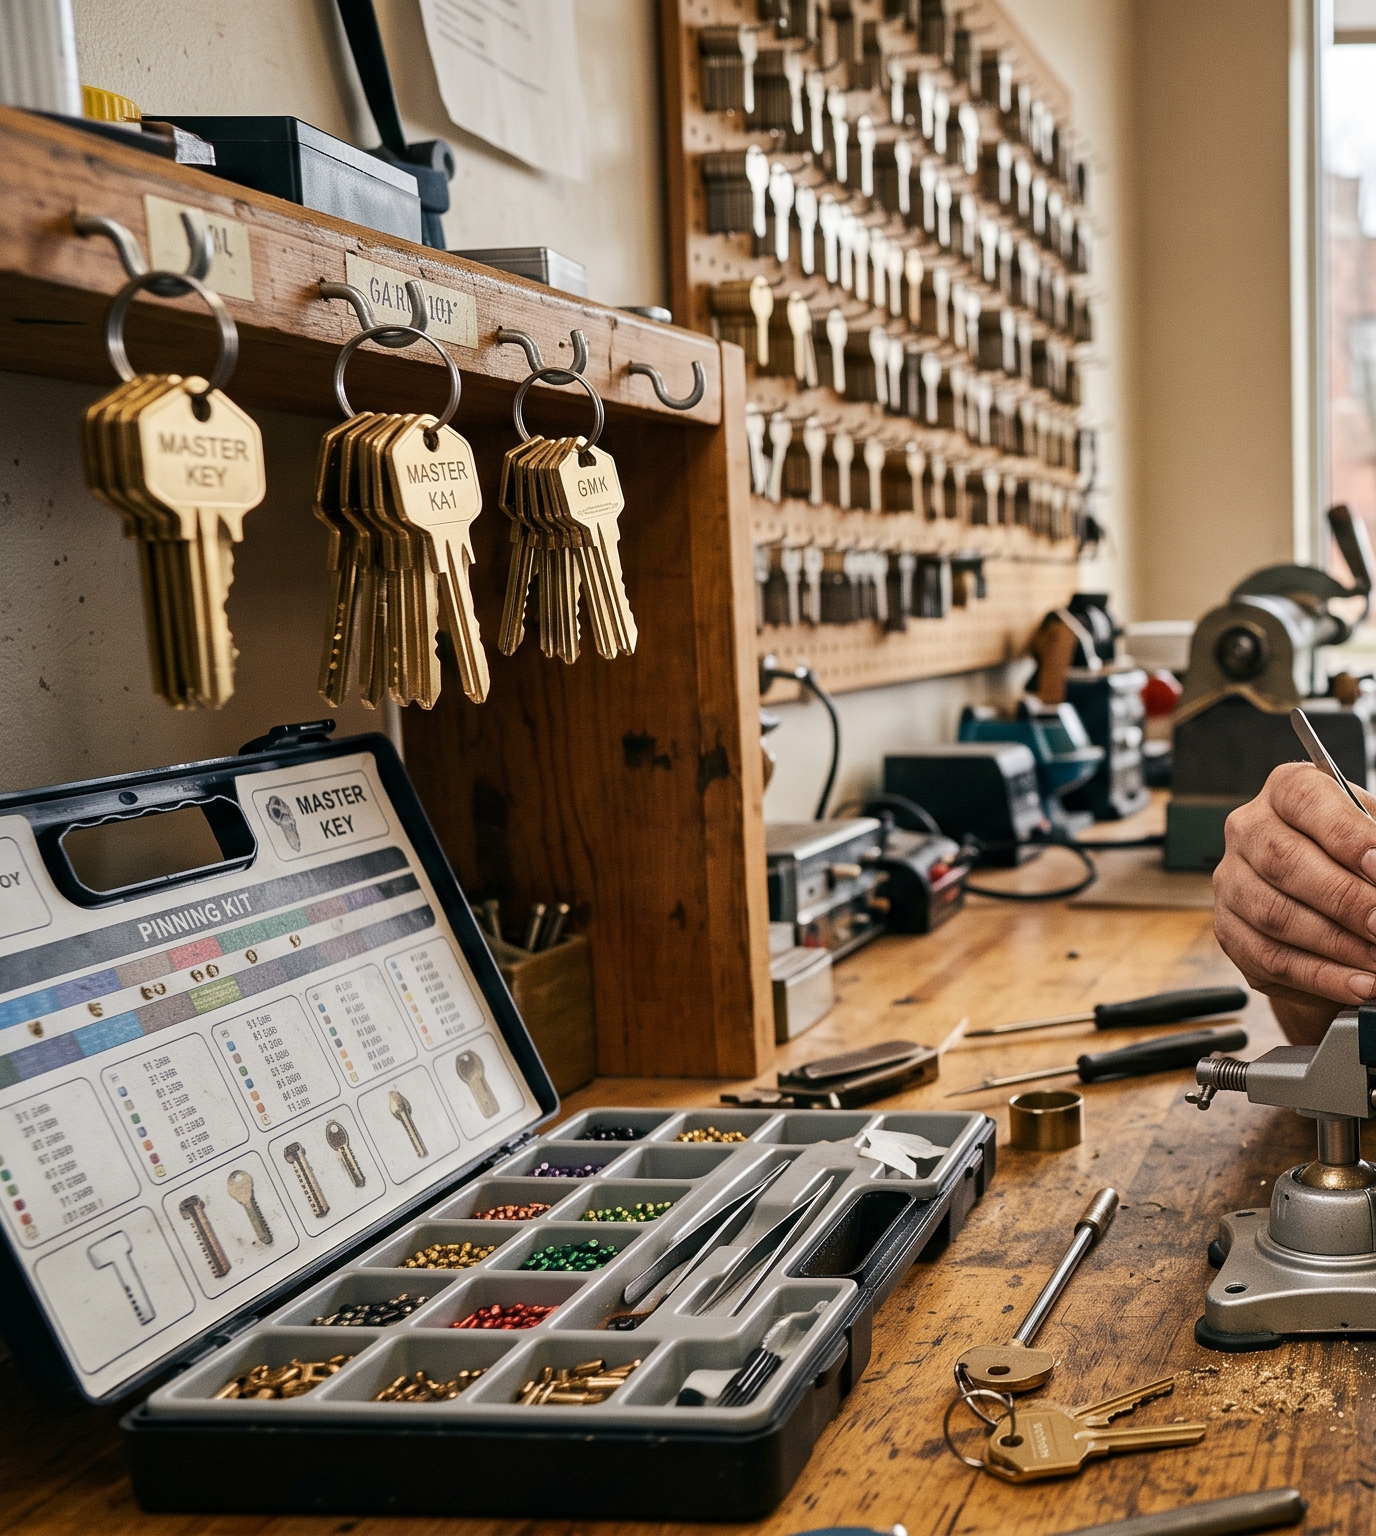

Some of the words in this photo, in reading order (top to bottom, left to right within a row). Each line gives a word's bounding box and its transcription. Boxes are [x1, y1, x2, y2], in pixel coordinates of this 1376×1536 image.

[158, 431, 249, 461] MASTER
[185, 464, 227, 487] KEY
[406, 461, 468, 484] MASTER
[577, 476, 608, 497] GMK
[428, 489, 457, 511] KA1
[295, 784, 367, 815] MASTER
[319, 814, 354, 839] KEY
[137, 903, 221, 943] PINNING
[220, 893, 252, 918] KIT
